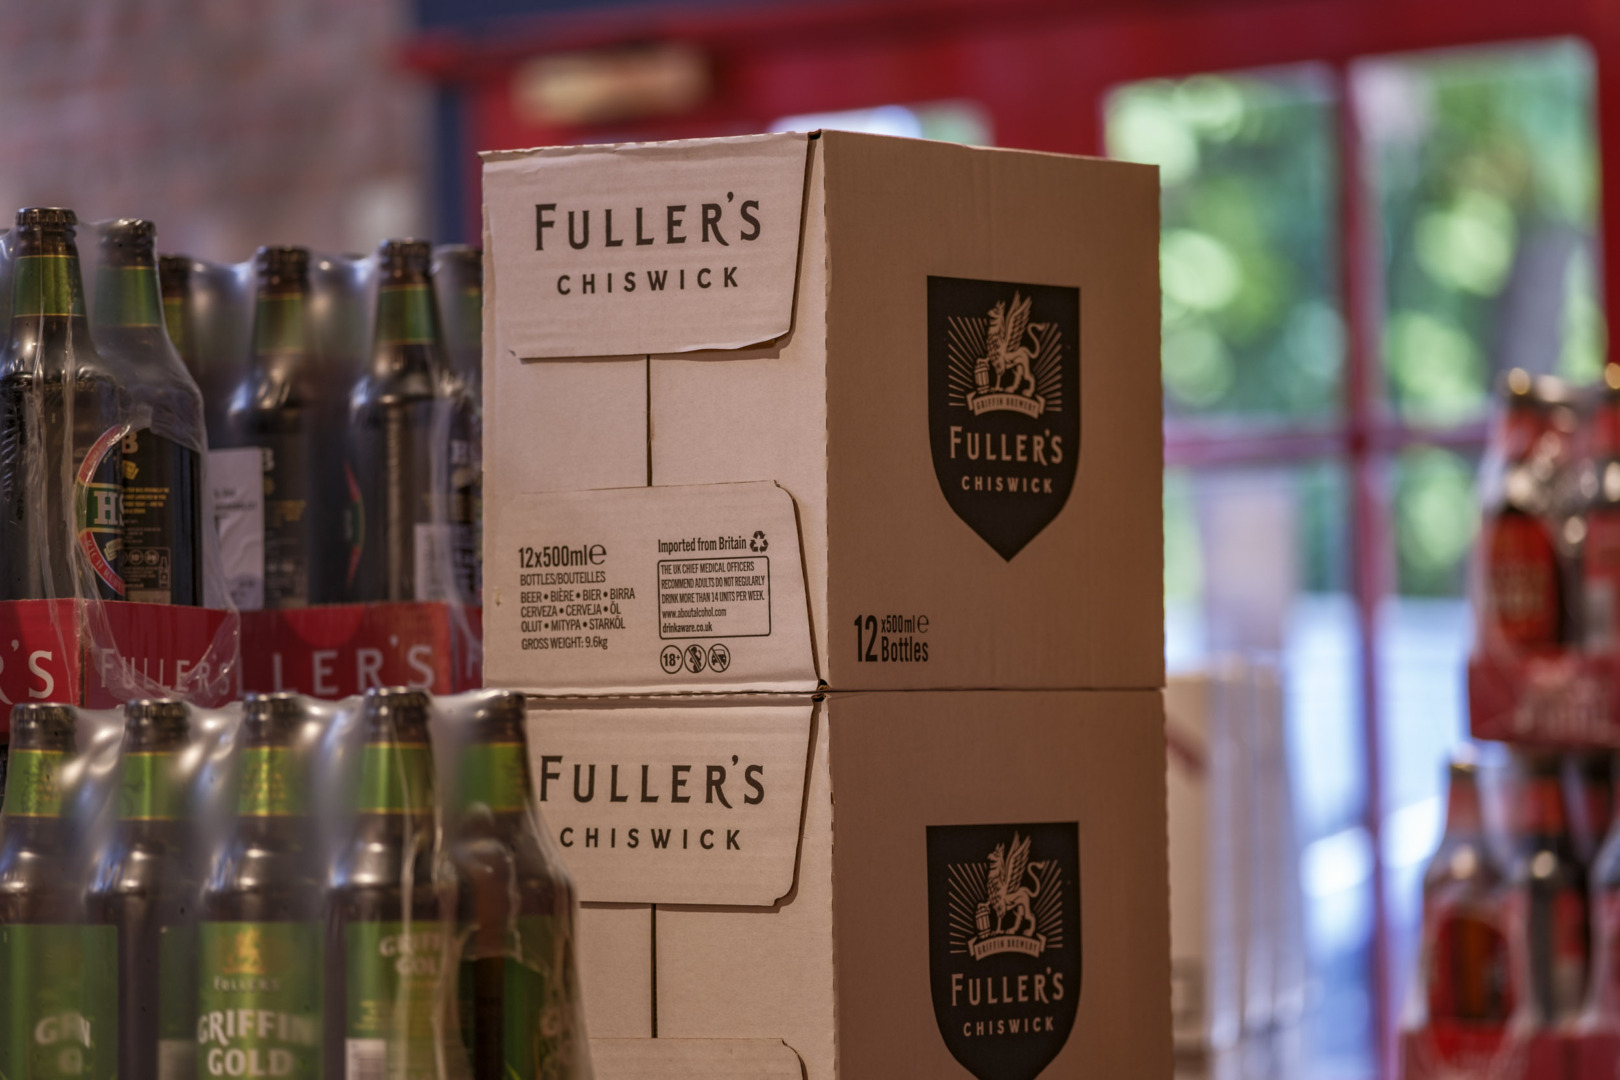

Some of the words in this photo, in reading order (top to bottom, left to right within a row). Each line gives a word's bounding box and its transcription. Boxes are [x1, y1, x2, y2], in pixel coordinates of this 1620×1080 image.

[535, 191, 761, 251] FULLER'S
[557, 266, 738, 295] CHISWICK
[950, 426, 1063, 466] FULLER'S
[961, 475, 1052, 494] CHISWICK
[658, 537, 696, 555] Imported
[697, 537, 717, 551] from
[718, 536, 747, 550] Britain
[661, 564, 672, 575] THE
[673, 563, 681, 574] UK
[682, 563, 699, 574] CHIEF
[700, 562, 726, 573] MEDICAL
[727, 561, 755, 572] OFFICERS
[520, 571, 606, 586] BOTTLES/BOUTEILLES
[661, 579, 695, 590] RECOMMEND
[695, 578, 715, 588] ADULTS
[715, 577, 723, 587] DO
[724, 576, 734, 587] NOT
[734, 575, 765, 586] REGULARLY
[520, 591, 542, 604] BEER
[550, 587, 575, 602] BIÈRE
[582, 589, 602, 601] BIER
[610, 587, 635, 600] BIRRA
[661, 593, 679, 604] DRINK
[679, 593, 695, 603] MORE
[695, 592, 711, 603] THAN
[711, 592, 719, 602] 14
[720, 591, 735, 602] UNITS
[736, 591, 748, 601] PER
[521, 605, 558, 618] CERVEZA
[565, 603, 602, 616] CERVEJA
[662, 607, 727, 619] www.aboutalcohol.com
[521, 620, 542, 633] OLUT
[551, 619, 581, 631] MITYPA
[662, 621, 713, 633] drinkaware.co.uk
[521, 637, 549, 650] GROSS
[550, 636, 584, 649] WEIGHT:
[585, 636, 608, 650] 9.6kg
[854, 614, 878, 662] 12
[881, 636, 929, 662] Bottles
[539, 754, 765, 809] FULLER'S
[560, 827, 741, 850] CHISWICK
[951, 966, 1064, 1006] FULLER'S
[963, 1016, 1054, 1037] CHISWICK
[207, 1046, 296, 1077] GOLD
